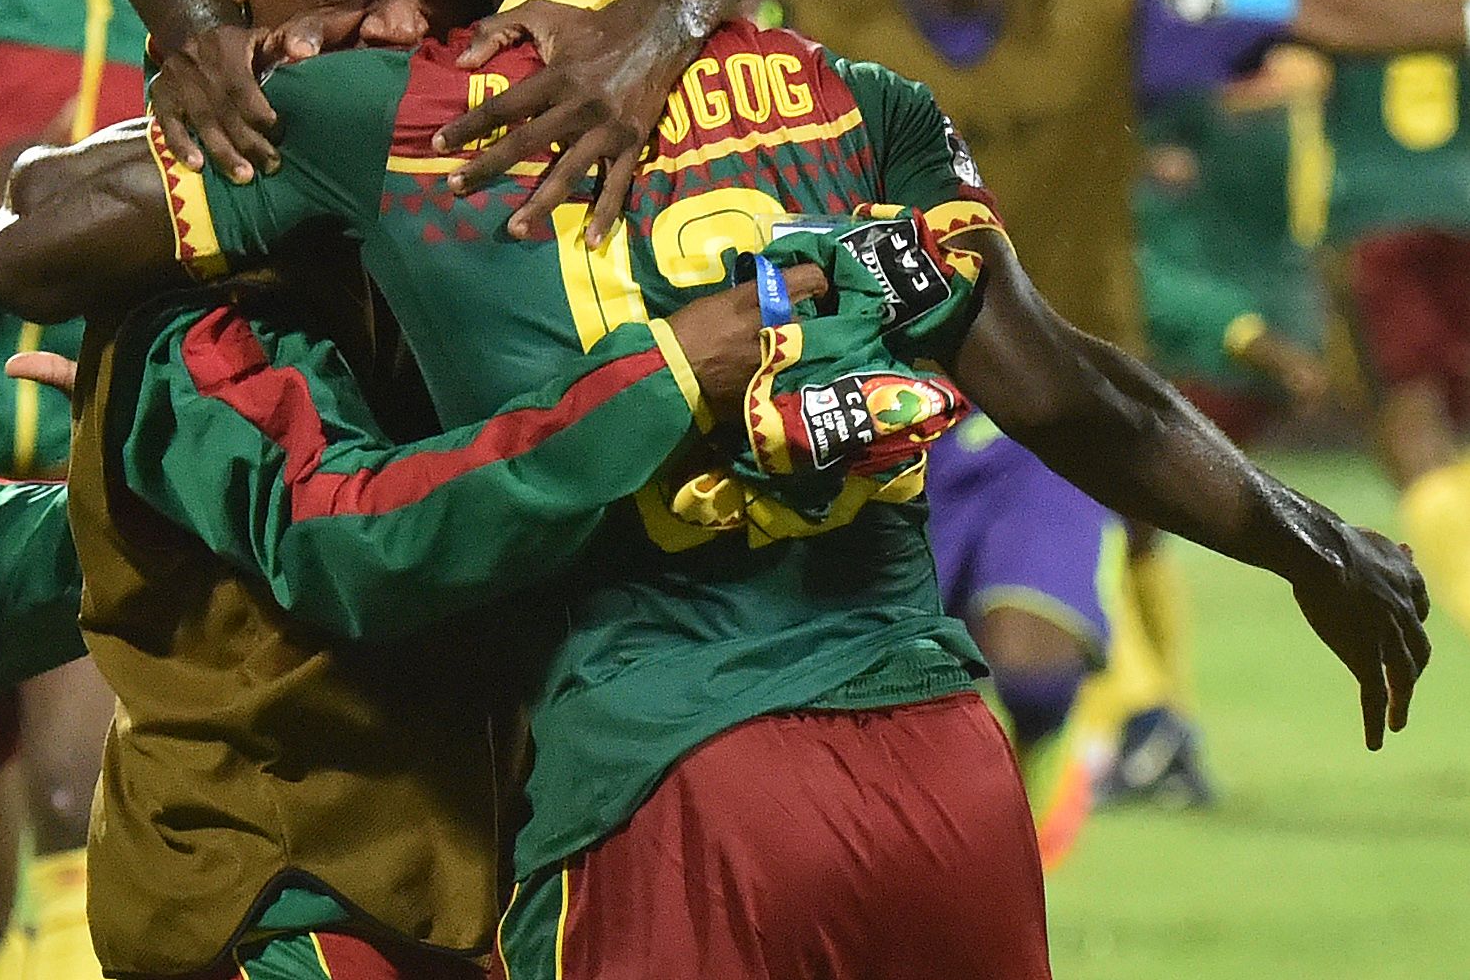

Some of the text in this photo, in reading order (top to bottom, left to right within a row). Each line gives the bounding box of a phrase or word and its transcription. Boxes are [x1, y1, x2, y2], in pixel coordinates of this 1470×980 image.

[890, 232, 930, 292] CAF
[811, 414, 823, 428] OF
[822, 411, 836, 431] CUP
[832, 409, 850, 443] AFRICA
[845, 391, 873, 444] CAF
